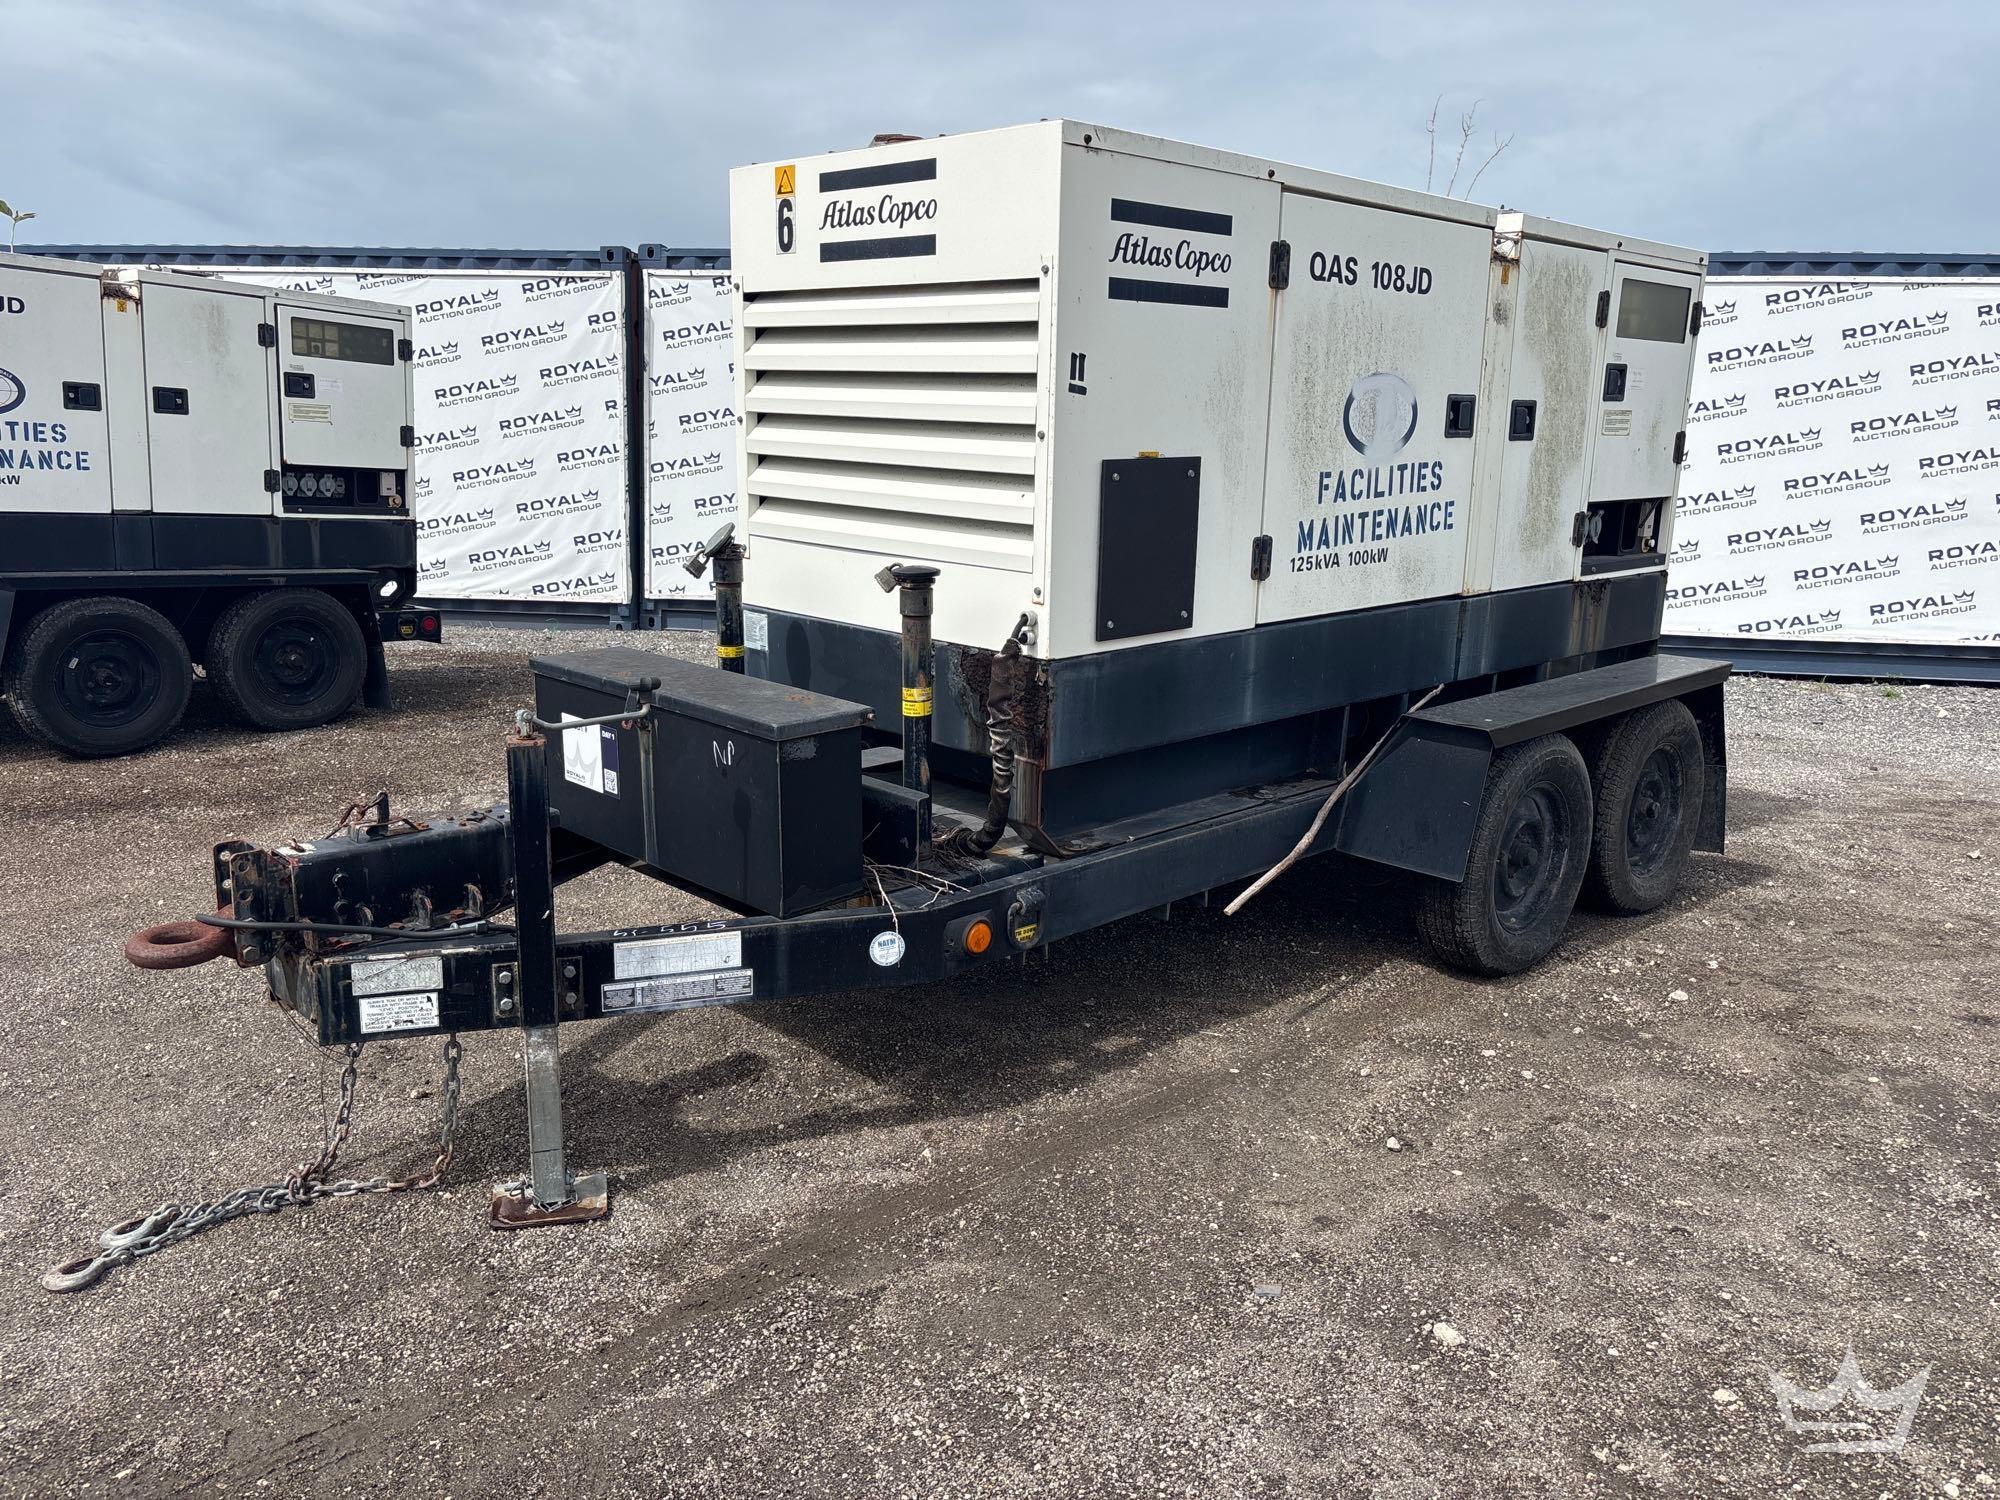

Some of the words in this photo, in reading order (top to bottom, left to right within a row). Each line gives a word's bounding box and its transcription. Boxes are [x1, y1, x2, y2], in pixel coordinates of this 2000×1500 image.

[819, 200, 875, 230] Atlas
[878, 195, 937, 229] Copco
[778, 199, 793, 252] 6
[1108, 233, 1172, 267] Atlas
[1176, 240, 1231, 277] Copco
[1310, 252, 1358, 285] QAS
[1371, 262, 1432, 294] 108JD
[360, 278, 404, 290] AUCTION
[525, 288, 571, 303] AUCTION
[573, 281, 609, 294] GROUP
[1766, 282, 1848, 306] ROYAL
[415, 294, 482, 315] ROYAL
[655, 296, 692, 308] GROUP
[1768, 301, 1822, 316] AUCTION
[1824, 291, 1873, 305] GROUP
[419, 310, 464, 324] AUCTION
[467, 303, 502, 315] GROUP
[1700, 315, 1738, 328] ROUP
[481, 325, 549, 347] ROYAL
[591, 324, 618, 334] AUCT
[663, 320, 732, 342] ROYAL
[1842, 316, 1926, 340] ROYAL
[1844, 335, 1901, 350] AUCTION
[1903, 326, 1950, 341] GROUP
[484, 341, 530, 355] AUCTION
[532, 334, 567, 346] GROUP
[666, 336, 712, 350] AUCTION
[714, 332, 733, 342] GRO
[426, 355, 462, 367] GROUP
[1708, 340, 1790, 364] ROYAL
[1710, 358, 1767, 373] AUCTION
[1769, 350, 1814, 363] GROUP
[540, 358, 606, 379] ROYAL
[1910, 354, 1994, 376] ROYAL
[543, 374, 588, 388] AUCTION
[590, 368, 619, 379] GROU
[649, 372, 688, 387] YAL
[1912, 371, 1969, 386] AUCTION
[1972, 366, 2000, 376] GRO
[434, 379, 500, 400] ROYAL
[438, 395, 483, 408] AUCTION
[485, 387, 519, 400] GROUP
[672, 381, 708, 393] GROUP
[1774, 376, 1858, 400] ROYAL
[1776, 394, 1833, 408] AUCTION
[1836, 385, 1882, 398] GROUP
[499, 411, 565, 431] ROYAL
[679, 408, 735, 426] ROYA
[1703, 408, 1748, 421] GROUP
[1851, 410, 1934, 434] ROYAL
[415, 430, 460, 447] OYAL
[502, 426, 547, 439] AUCTION
[549, 419, 584, 430] GROUP
[682, 422, 728, 434] AUCTION
[1852, 428, 1910, 443] AUCTION
[1912, 420, 1959, 433] GROUP
[415, 446, 442, 456] CTION
[445, 439, 480, 450] GROUP
[557, 444, 619, 464] ROYAL
[1718, 433, 1799, 455] ROYAL
[1720, 450, 1775, 464] AUCTION
[1778, 442, 1823, 456] GROUP
[560, 456, 605, 472] AUCTION
[651, 457, 703, 473] OYAL
[1919, 447, 2000, 470] ROYAL
[453, 462, 518, 483] ROYAL
[456, 478, 499, 491] AUCTION
[502, 471, 537, 483] GROUP
[687, 465, 723, 477] GROUP
[1784, 469, 1867, 491] ROYAL
[1921, 465, 1978, 479] AUCTION
[1318, 461, 1443, 504] FACILITIES
[1786, 486, 1843, 500] AUCTION
[1846, 478, 1891, 491] GROUP
[516, 494, 582, 514] ROYAL
[695, 493, 736, 509] ROY
[1675, 507, 1710, 518] CTION
[1713, 500, 1757, 511] GROUP
[1676, 490, 1733, 508] OYAL
[417, 512, 477, 531] ROYAL
[519, 509, 564, 522] AUCTION
[566, 503, 602, 515] GROUP
[1860, 503, 1943, 525] ROYAL
[417, 528, 459, 539] AUCTION
[462, 521, 496, 532] GROUP
[1298, 501, 1455, 553] MAINTENANCE
[1862, 521, 1919, 535] AUCTION
[1923, 513, 1968, 526] GROUP
[1727, 525, 1809, 546] ROYAL
[1729, 541, 1785, 556] AUCTION
[1788, 533, 1832, 546] GROUP
[469, 545, 534, 564] ROYAL
[577, 542, 622, 555] AUCTION
[652, 541, 706, 558] ROYA
[1669, 554, 1701, 564] ROUP
[1928, 542, 1997, 561] ROYA
[472, 560, 516, 572] AUCTION
[519, 553, 553, 565] GROUP
[1290, 553, 1340, 572] 125kVA
[1348, 548, 1388, 566] 100kW
[1794, 559, 1876, 581] ROYAL
[1930, 557, 1987, 570] AUCTION
[532, 576, 599, 595] ROYAL
[1665, 580, 1744, 600] ROYAL
[1796, 577, 1852, 591] AUCTION
[1855, 569, 1900, 583] GROUP
[583, 585, 618, 597] GROUP
[1667, 596, 1720, 610] AUCTION
[1724, 589, 1767, 601] GROUP
[1870, 594, 1954, 616] ROYAL
[1872, 612, 1928, 625] AUCTION
[1932, 604, 1977, 617] GROUP
[1738, 615, 1819, 633] ROYAL
